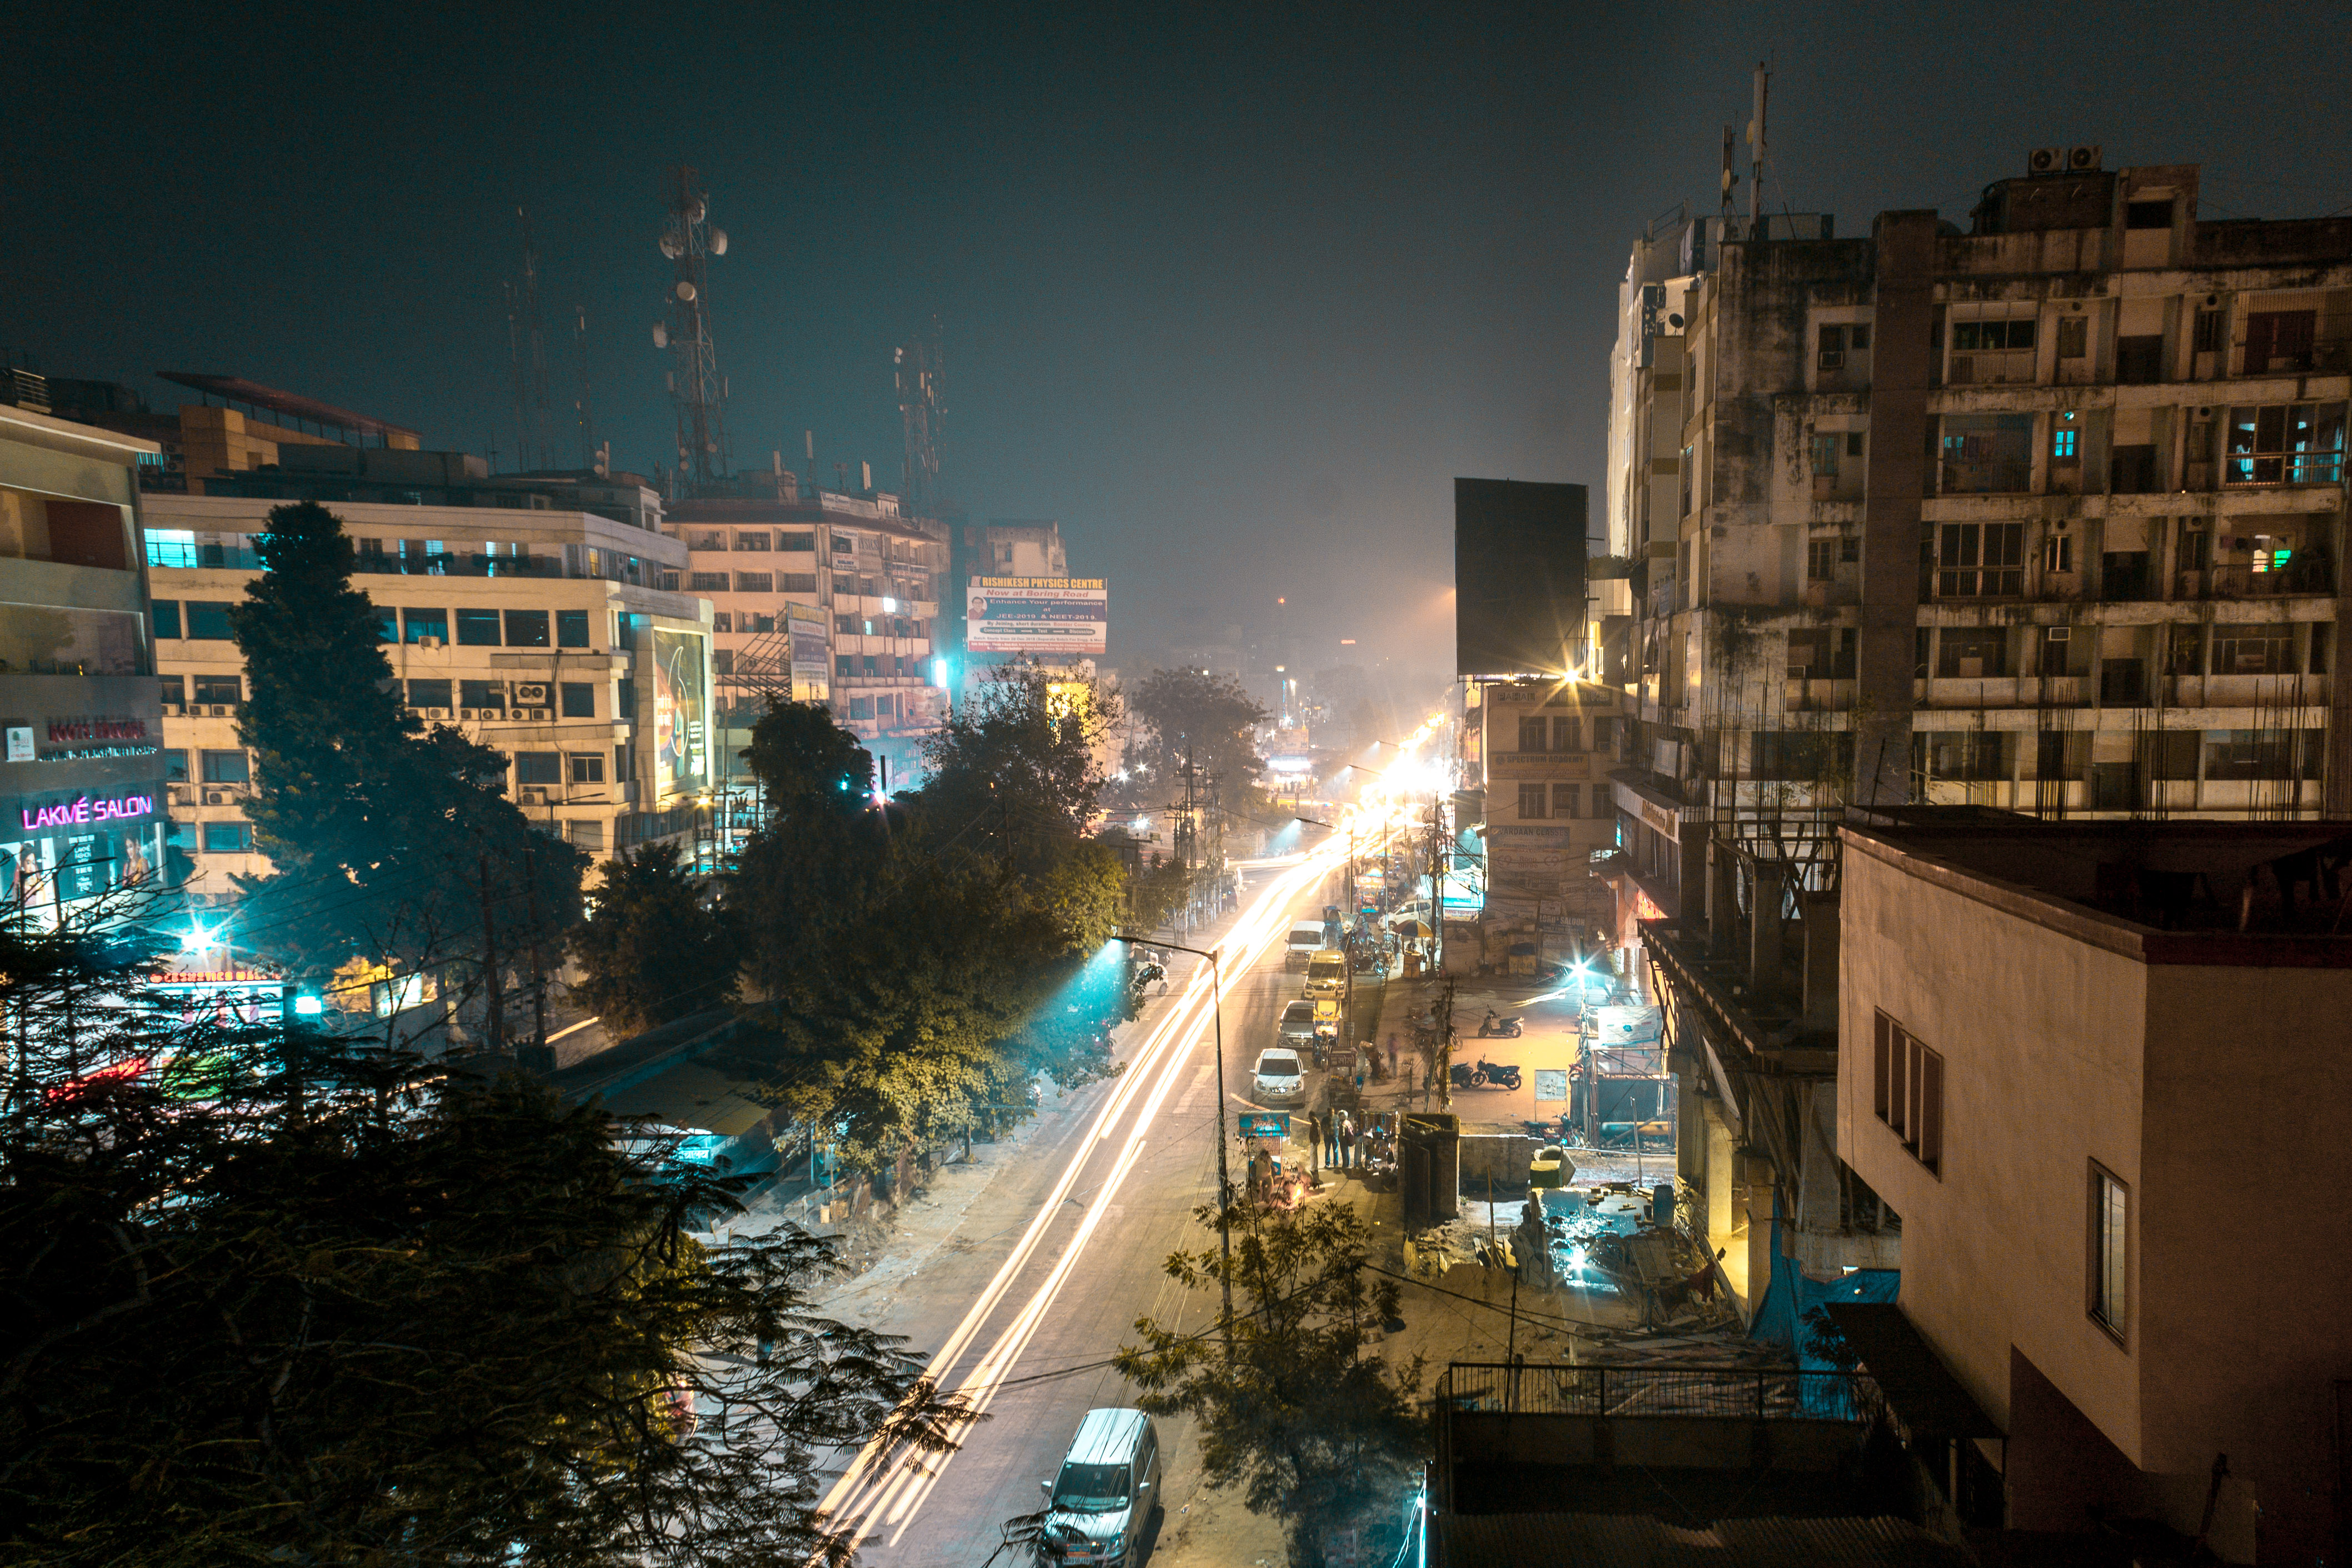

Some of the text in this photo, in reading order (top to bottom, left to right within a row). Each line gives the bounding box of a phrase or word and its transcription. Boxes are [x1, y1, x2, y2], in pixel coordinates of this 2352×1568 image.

[982, 577, 1103, 589] RISHIKESH PHYSICS CENTRE
[1548, 755, 1584, 764] ACADEMY
[23, 795, 153, 830] LAKMÉ SALON
[1536, 828, 1569, 836] CLASSES
[1560, 916, 1585, 926] SALOON
